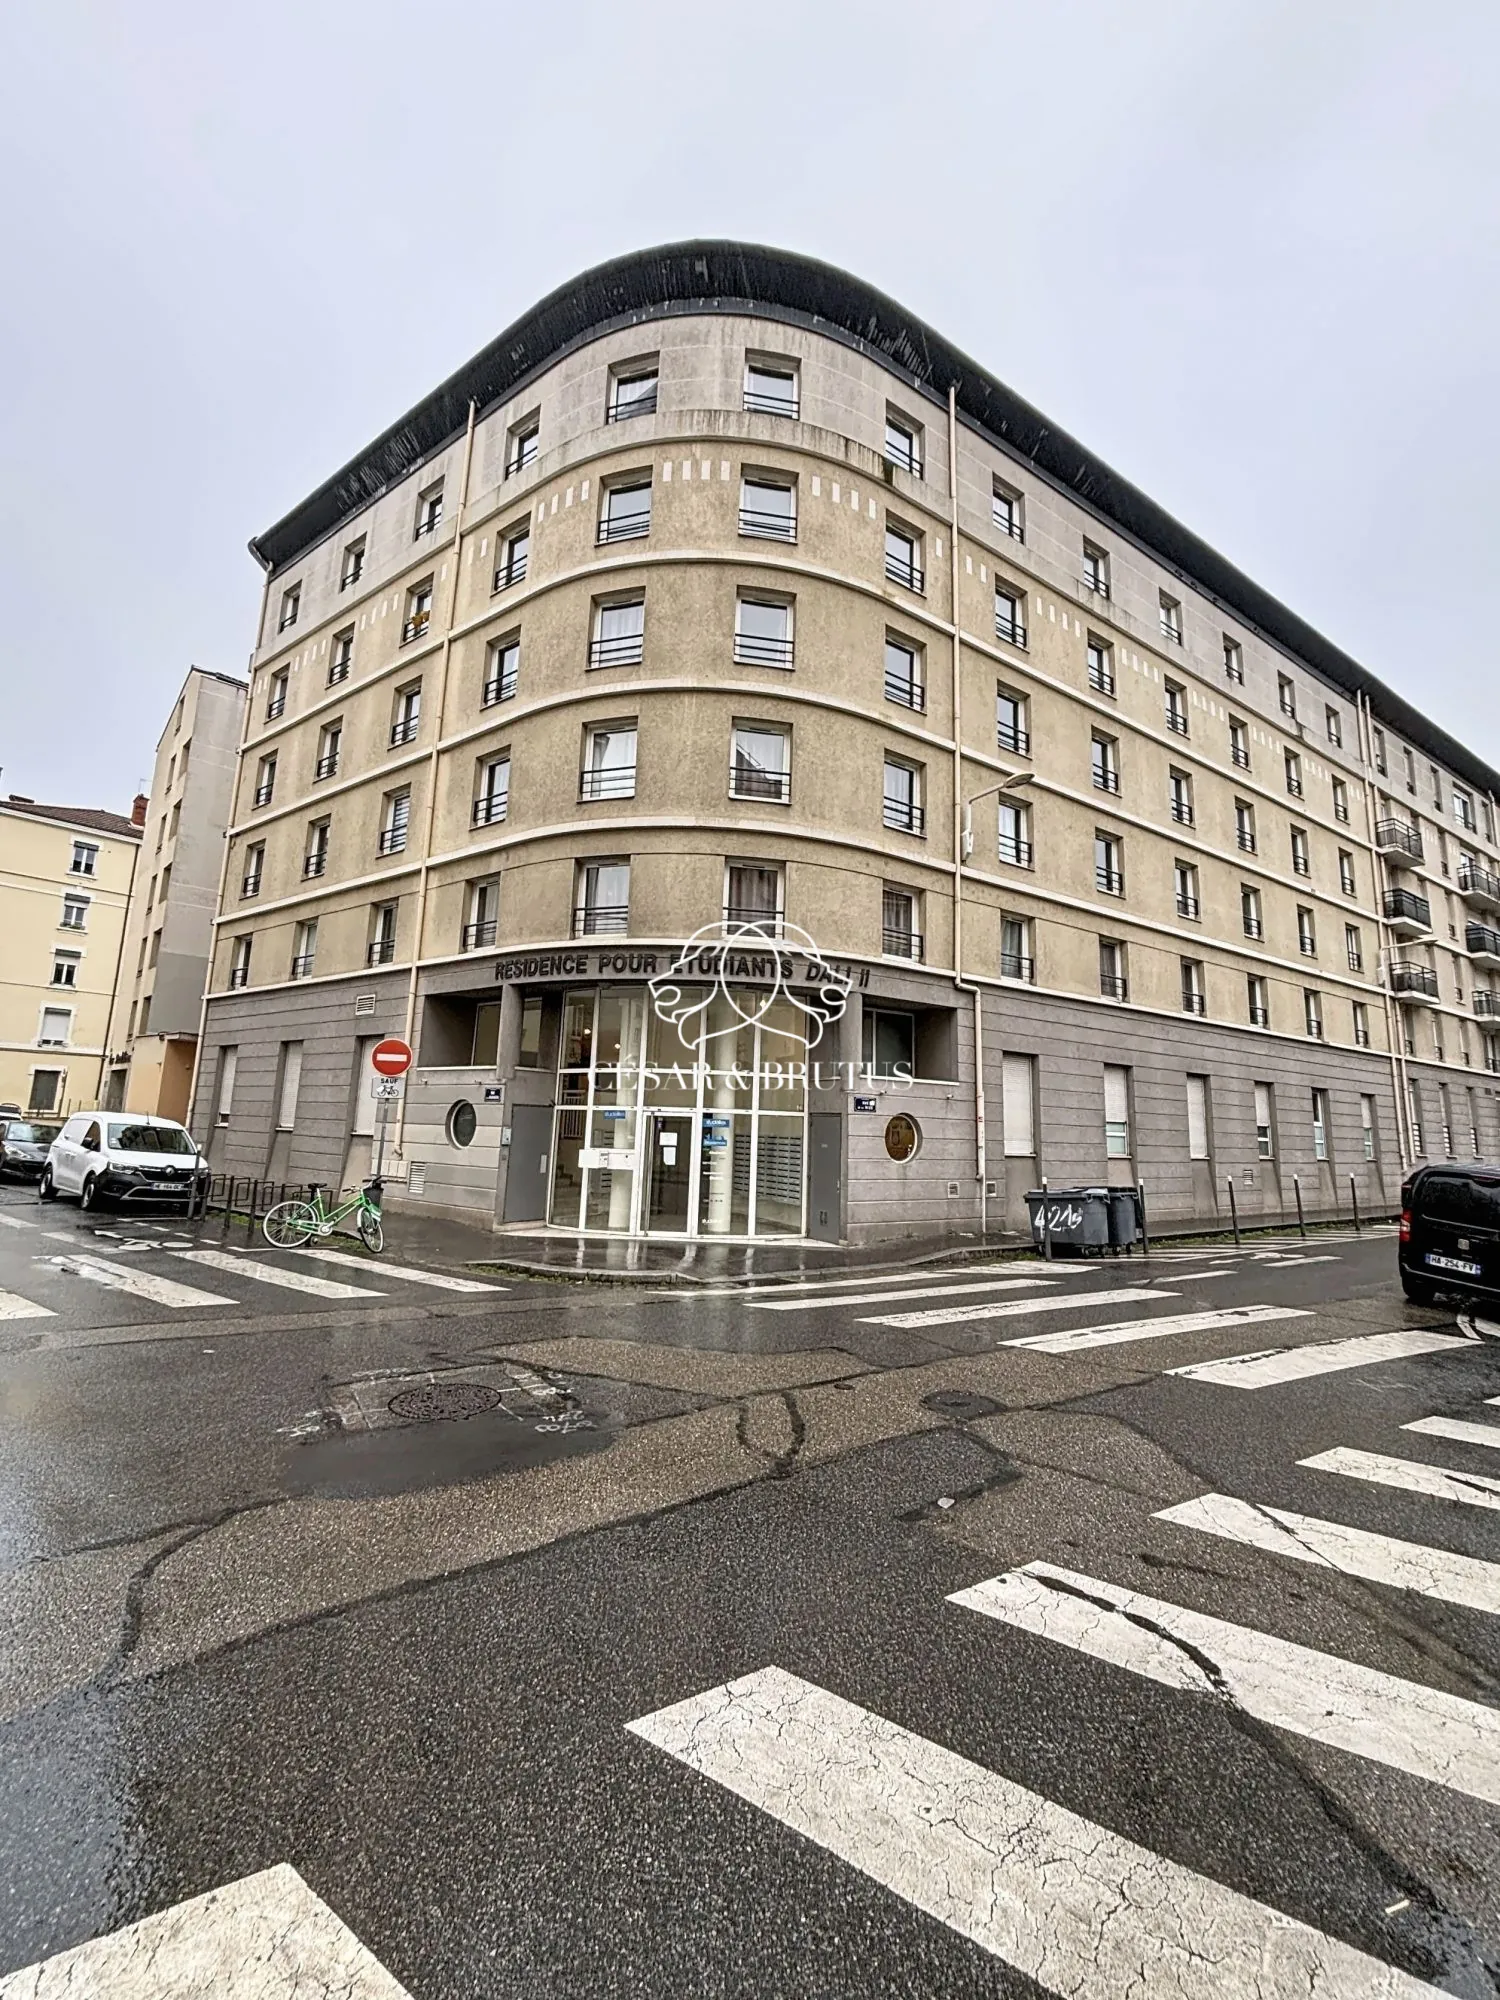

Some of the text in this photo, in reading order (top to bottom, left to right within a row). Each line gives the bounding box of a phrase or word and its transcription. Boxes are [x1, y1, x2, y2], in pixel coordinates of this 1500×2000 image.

[495, 954, 588, 980] RESIDENCE
[598, 953, 657, 974] POUR
[670, 954, 793, 979] ETUDIANTS
